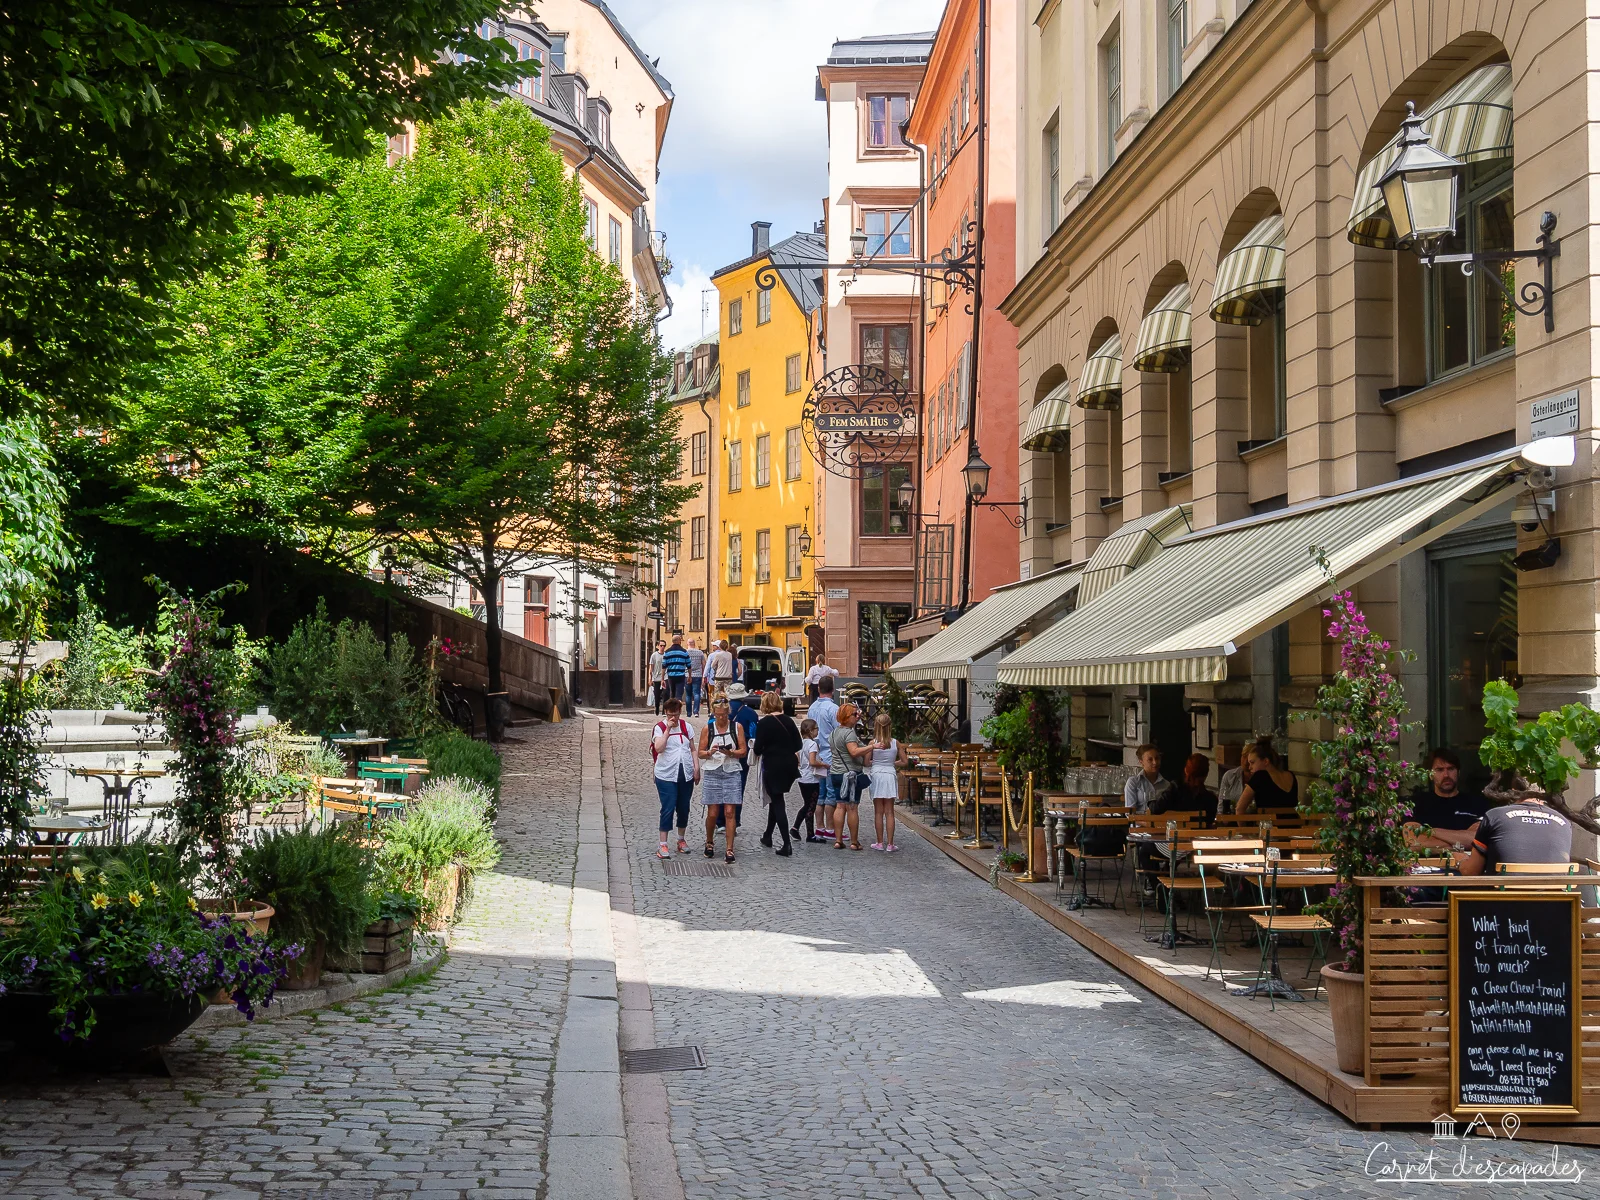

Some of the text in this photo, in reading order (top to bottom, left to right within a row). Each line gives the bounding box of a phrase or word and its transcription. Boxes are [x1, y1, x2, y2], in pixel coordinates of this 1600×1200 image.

[802, 365, 916, 420] RESTAURANG
[1532, 397, 1577, 418] Österlånggatan
[829, 416, 889, 427] FEM SMÅ HUS
[1569, 414, 1577, 428] 17
[1521, 816, 1534, 824] EST.
[1472, 915, 1532, 943] What kind
[1475, 936, 1548, 960] of train eats
[1474, 956, 1530, 973] too much?
[1471, 978, 1566, 1002] a Chew Chew train!
[1467, 1046, 1484, 1060] omg
[1486, 1045, 1510, 1060] please
[1512, 1043, 1527, 1056] call
[1528, 1047, 1541, 1058] me
[1554, 1051, 1565, 1062] so
[1505, 1062, 1524, 1072] need
[1526, 1061, 1557, 1079] friends
